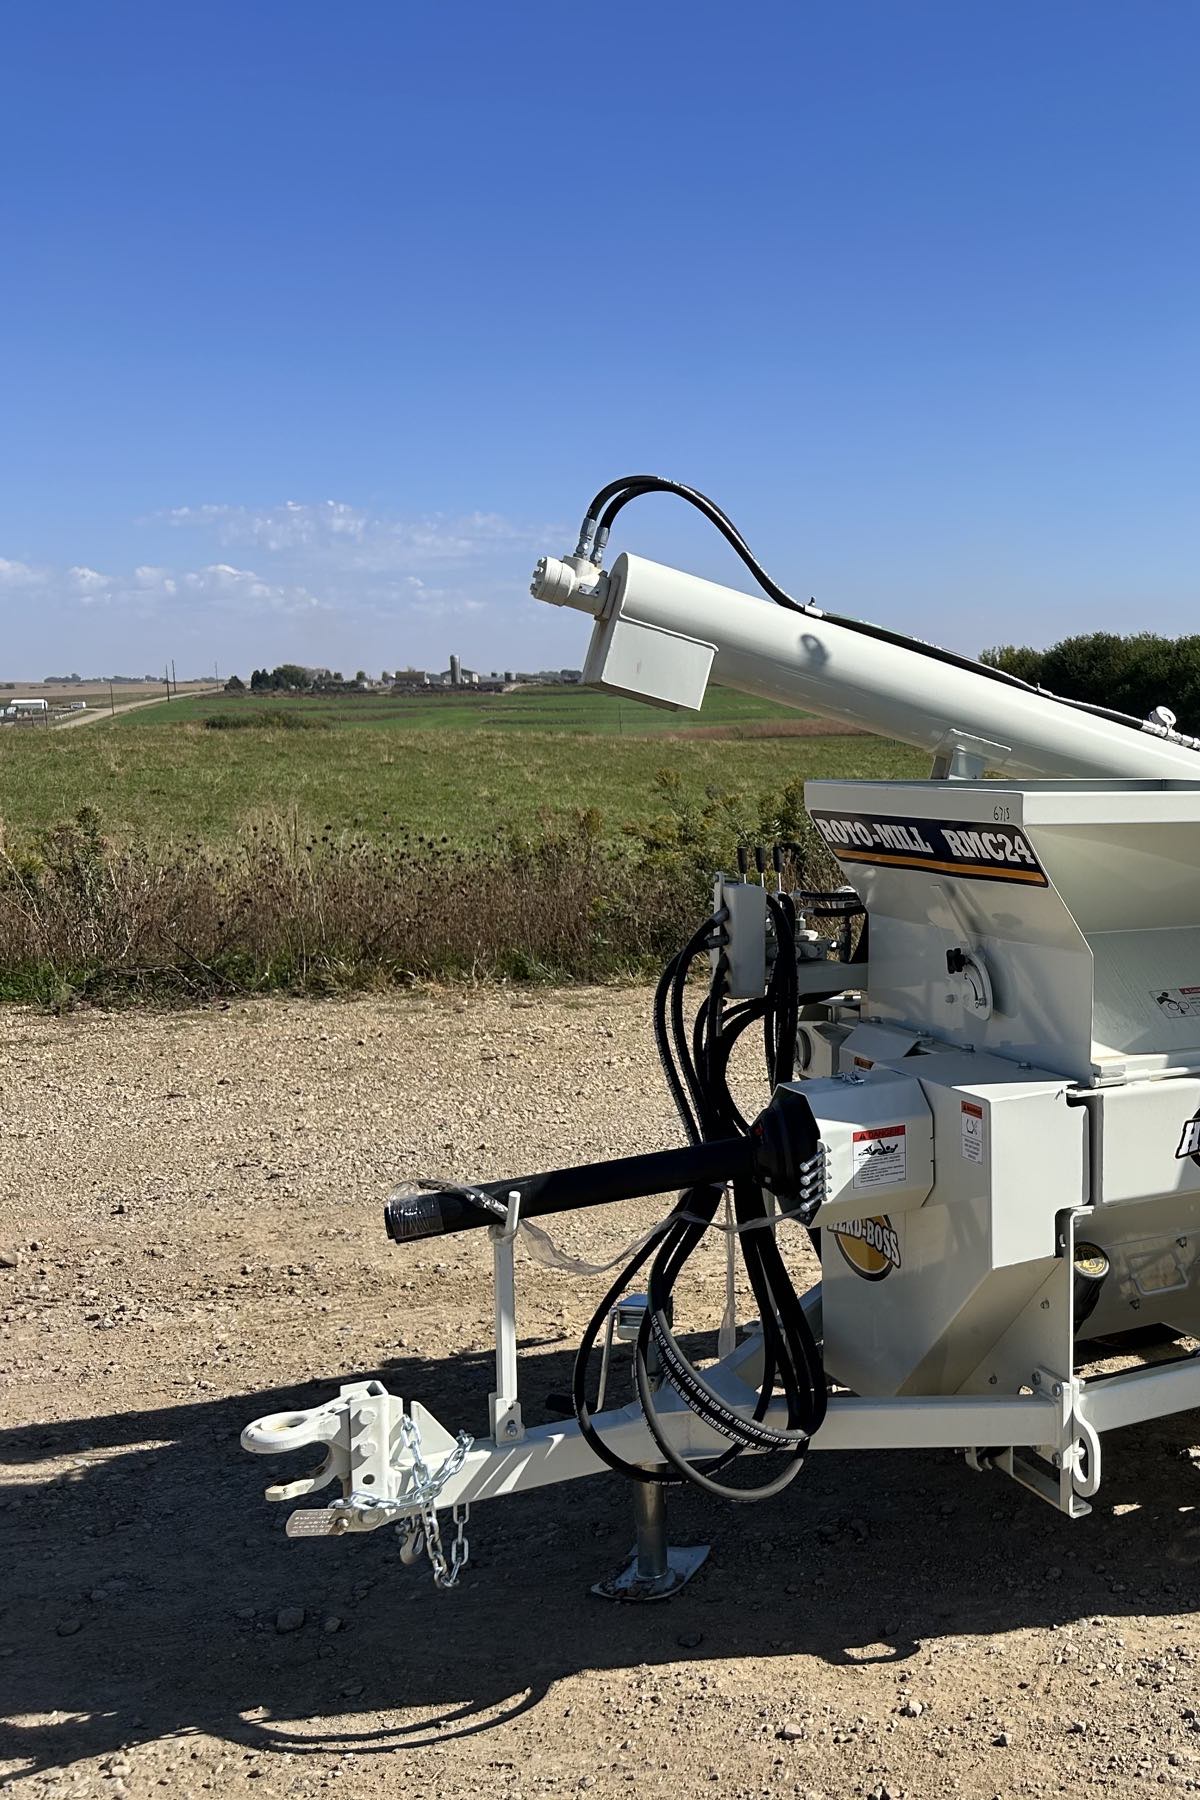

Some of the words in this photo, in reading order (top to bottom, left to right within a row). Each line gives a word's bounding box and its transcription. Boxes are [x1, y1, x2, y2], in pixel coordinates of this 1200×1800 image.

[815, 818, 934, 854] ROTO-MILL
[940, 829, 1036, 864] RMC24
[689, 1400, 701, 1413] SAE
[709, 1399, 721, 1411] WP
[720, 1409, 734, 1421] SAE
